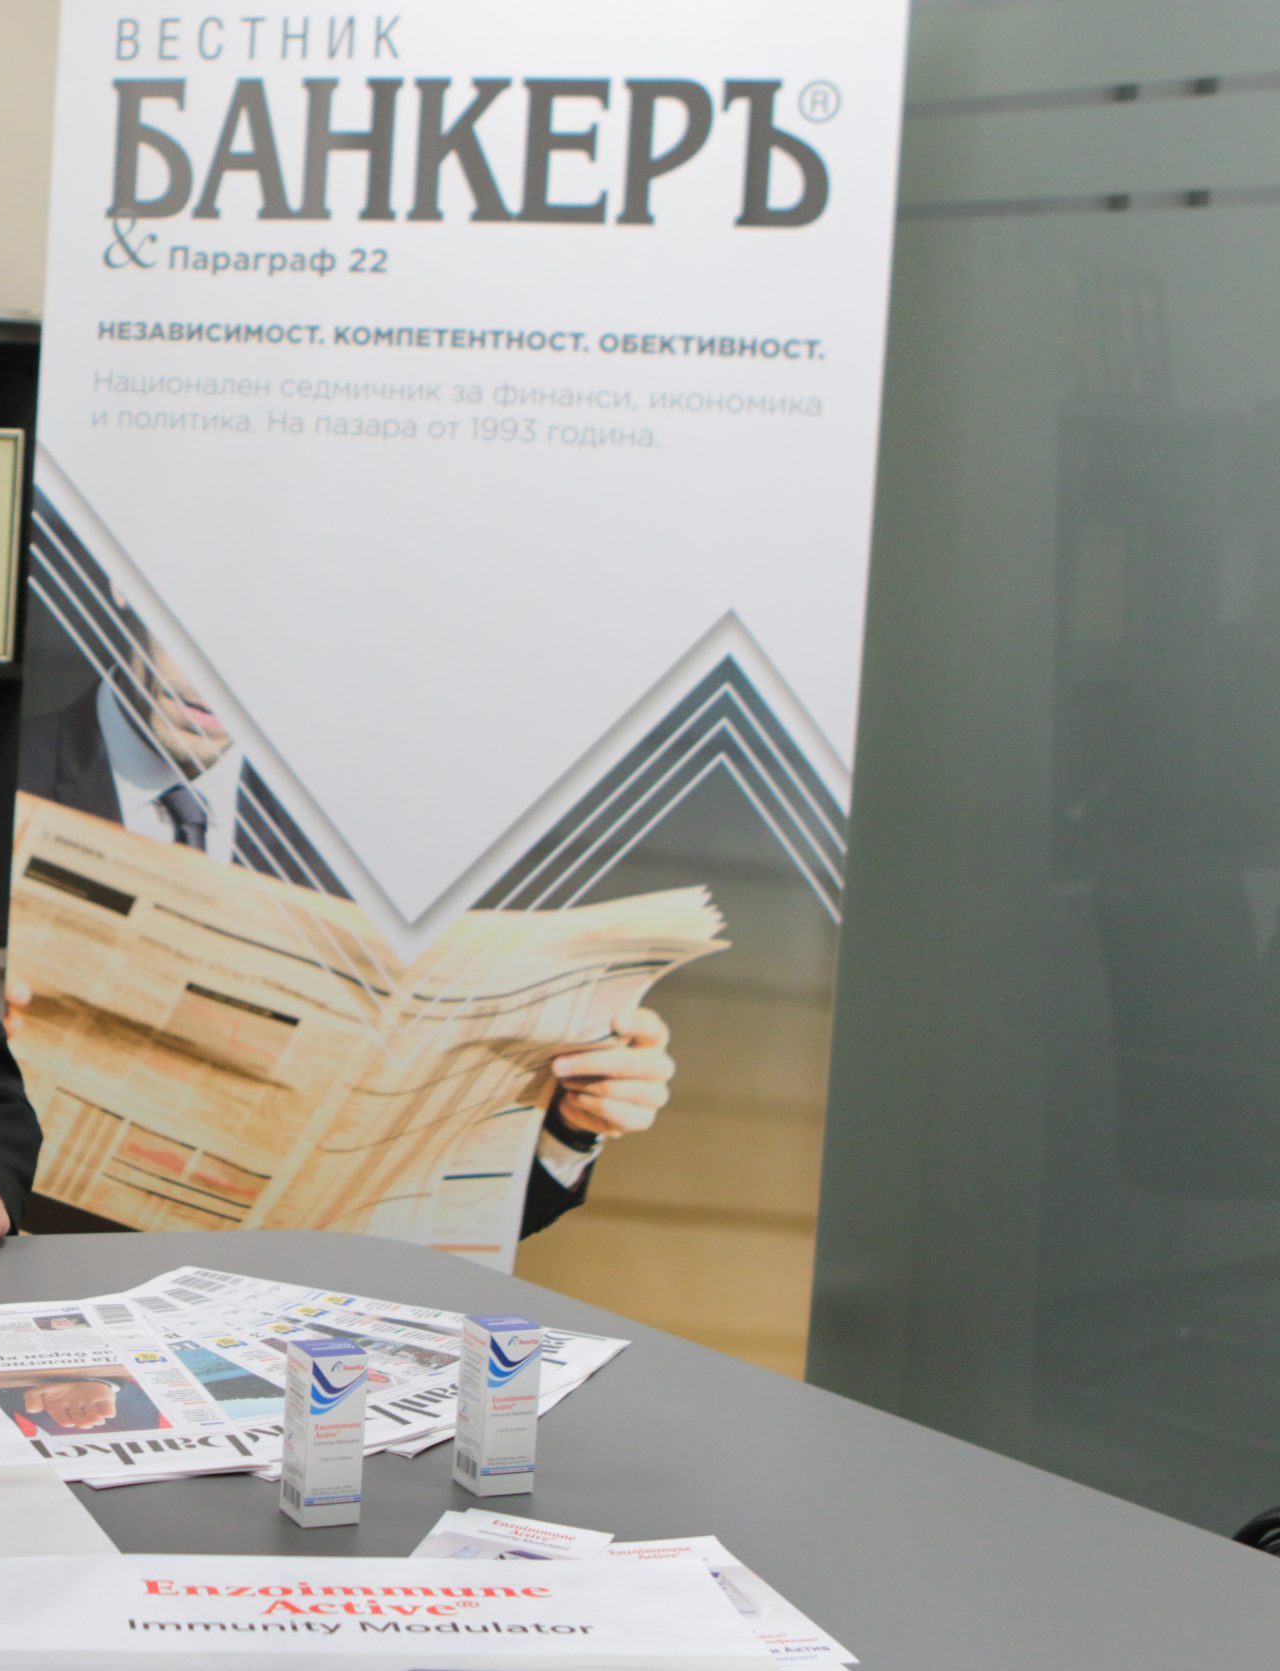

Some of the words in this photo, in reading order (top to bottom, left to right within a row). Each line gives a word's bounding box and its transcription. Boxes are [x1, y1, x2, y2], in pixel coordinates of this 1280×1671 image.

[115, 15, 401, 61] ВЕСТНИК
[102, 207, 157, 270] &
[168, 245, 337, 277] Параграф
[348, 247, 390, 273] 22
[97, 320, 325, 345] НЕЗАВИСИМОСТ.
[332, 326, 590, 353] КОМПЕТЕНТНОСТ.
[598, 332, 826, 360] ОБЕКТИВНОСТ.
[92, 369, 271, 397] Национален
[280, 377, 443, 403] седмичник
[452, 383, 483, 404] за
[492, 380, 639, 412] финанси,
[649, 391, 825, 418] икономика
[91, 410, 108, 428] и
[116, 409, 256, 434] политика.
[267, 411, 304, 434] На
[314, 416, 417, 442] пазара
[427, 418, 461, 439] от
[471, 416, 536, 443] 1993
[547, 423, 660, 450] година.
[490, 1519, 576, 1541] Enzoimmune
[140, 1578, 554, 1599] Enzoimmune
[128, 1618, 342, 1636] Immunity
[358, 1619, 595, 1636] Modulator
